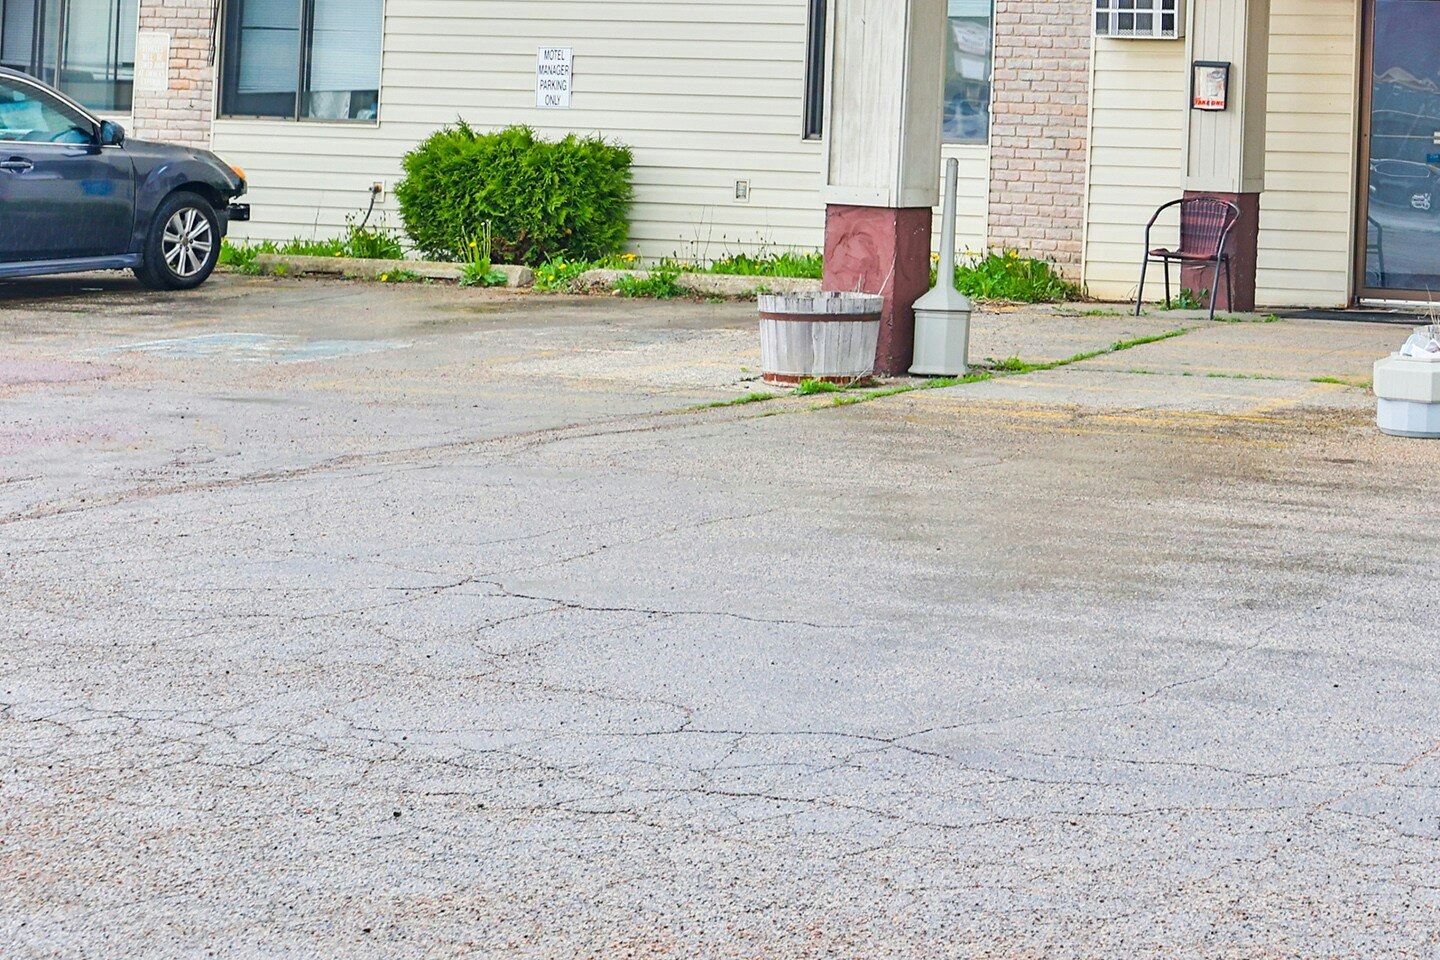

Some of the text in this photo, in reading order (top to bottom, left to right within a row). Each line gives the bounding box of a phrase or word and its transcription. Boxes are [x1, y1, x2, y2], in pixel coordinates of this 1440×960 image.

[543, 49, 565, 61] MOTEL
[538, 64, 570, 76] MANAGER
[539, 79, 567, 91] PARKING
[544, 94, 562, 106] ONLY
